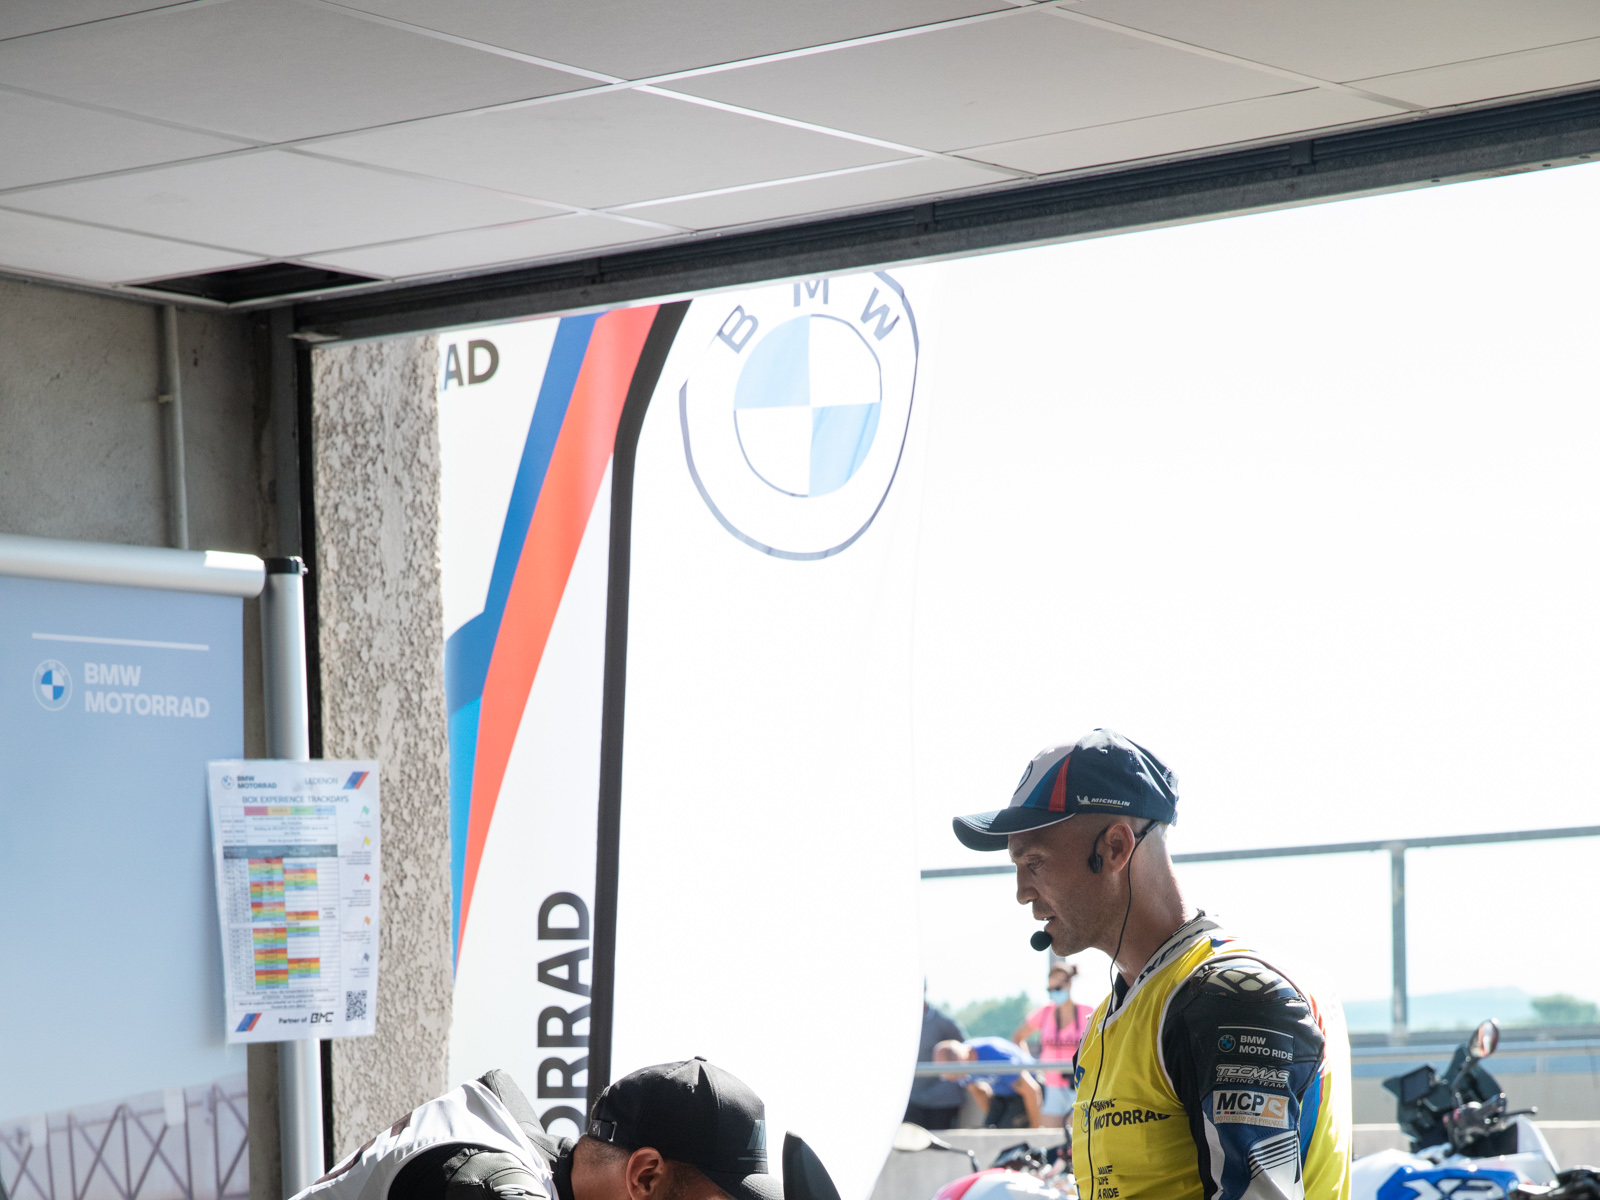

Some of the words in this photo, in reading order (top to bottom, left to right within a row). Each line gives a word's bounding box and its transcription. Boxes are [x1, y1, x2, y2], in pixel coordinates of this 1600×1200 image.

[84, 662, 142, 687] BMW
[84, 690, 211, 719] MOTORRAD
[237, 782, 278, 790] MOTORRAD
[242, 795, 258, 804] BOX
[260, 795, 304, 804] EXPERIENCE
[307, 795, 350, 803] TRACKDAYS
[1091, 797, 1131, 807] MICHELIN
[278, 1017, 300, 1025] Partner
[1240, 1035, 1267, 1045] BMW
[1239, 1045, 1270, 1056] MOTO
[1271, 1048, 1293, 1061] RIDE
[1216, 1064, 1290, 1084] TECMAS
[1216, 1077, 1254, 1085] RACING
[1258, 1080, 1286, 1089] TEAM
[1217, 1092, 1265, 1111] MCP
[1103, 1187, 1119, 1199] RIDE
